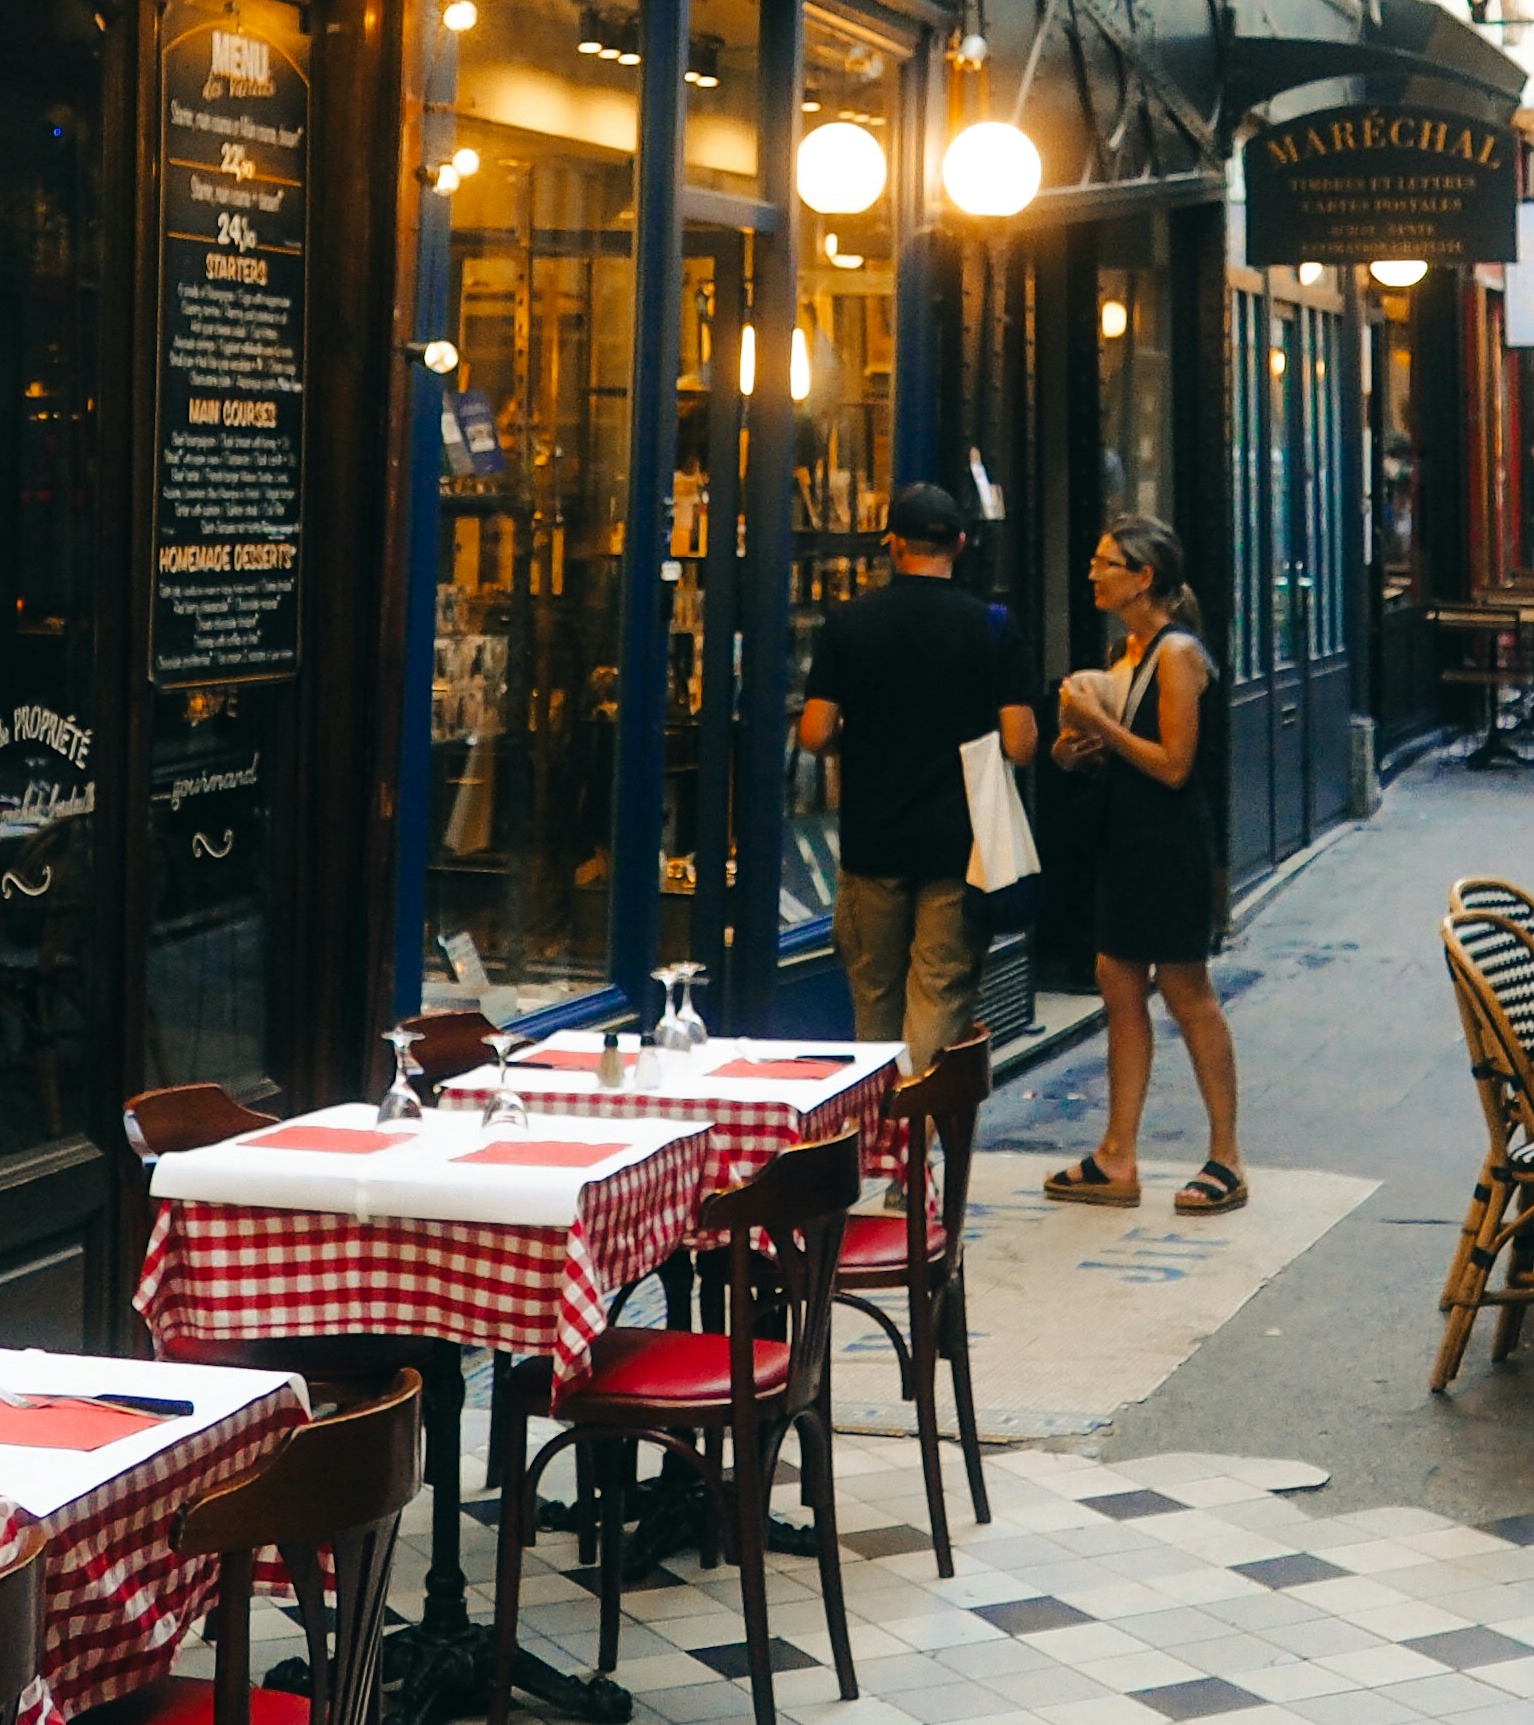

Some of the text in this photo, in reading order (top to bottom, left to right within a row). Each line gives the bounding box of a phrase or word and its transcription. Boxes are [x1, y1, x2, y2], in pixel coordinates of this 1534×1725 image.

[1266, 106, 1502, 170] MARÉCHAL
[188, 397, 221, 425] MAIN
[159, 545, 232, 574] HOMEMADE
[13, 704, 94, 771] PROPRIÉTÉ
